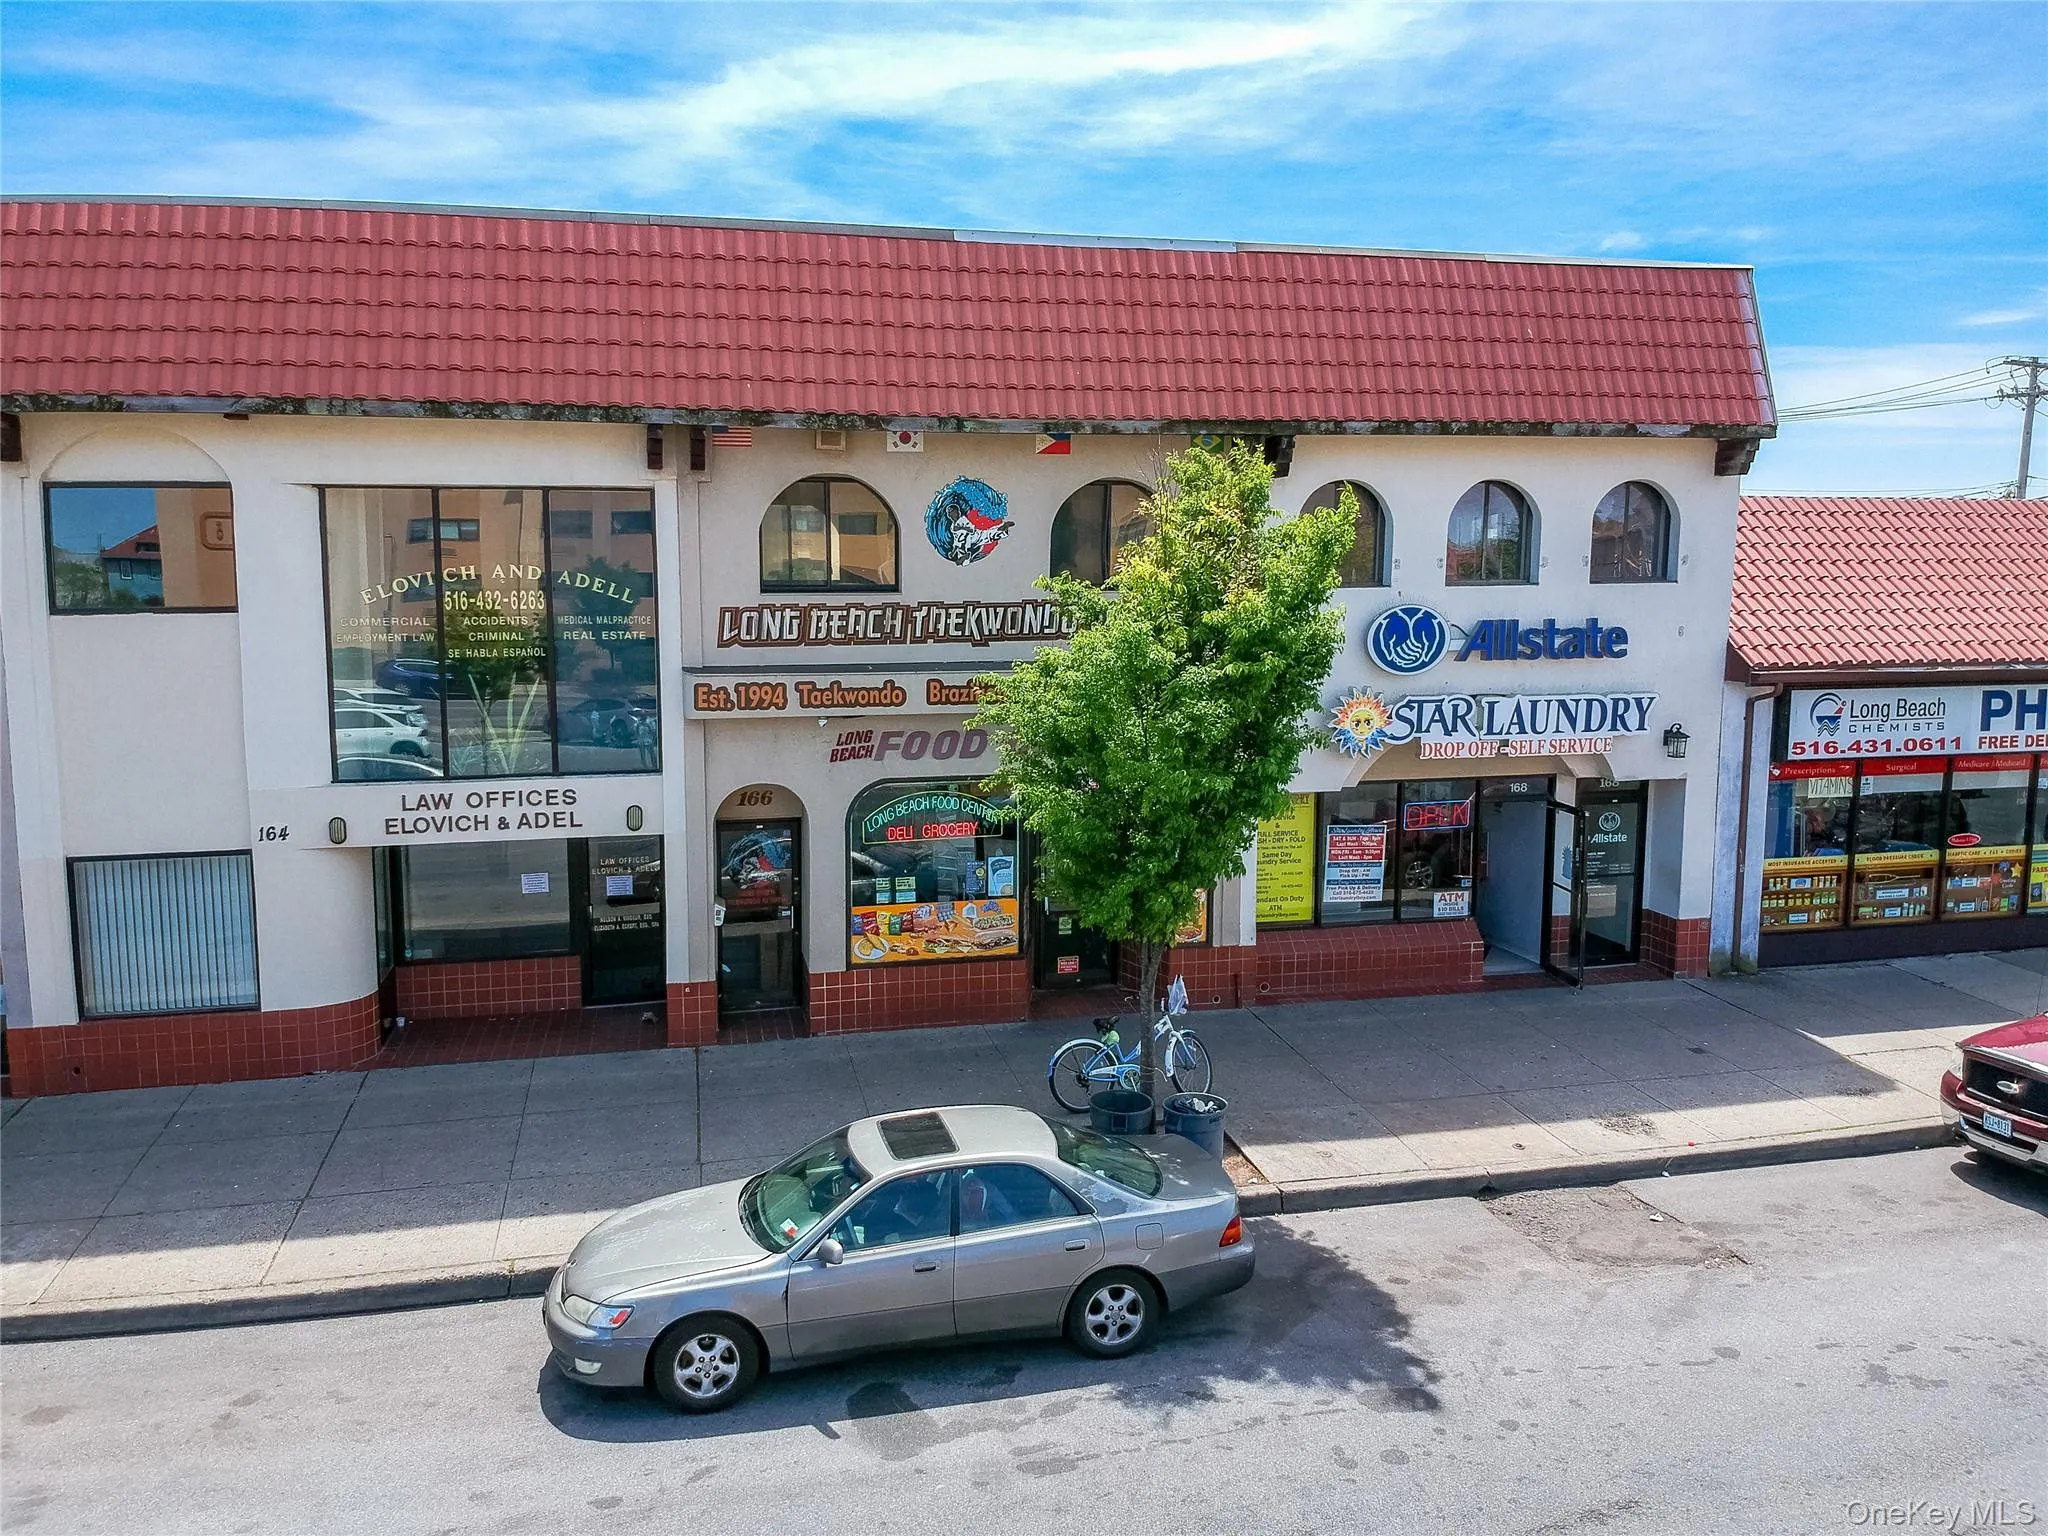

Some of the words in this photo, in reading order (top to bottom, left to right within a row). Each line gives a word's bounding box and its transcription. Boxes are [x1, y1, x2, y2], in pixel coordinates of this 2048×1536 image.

[360, 565, 477, 605] ELOVICH
[491, 564, 542, 580] AND
[557, 569, 634, 604] ADELL
[444, 590, 545, 610] 516-432-6263
[340, 616, 431, 627] COMMERCIAL
[463, 615, 529, 626] ACCIDENTS
[557, 615, 593, 625] MEDICAL
[596, 615, 652, 625] MALPRACTICE
[722, 607, 801, 641] LONG
[809, 606, 903, 640] BEACH
[336, 633, 408, 643] EMPLOYMENT
[412, 632, 435, 642] LAW
[468, 631, 525, 641] CRIMINAL
[563, 630, 597, 640] REAL
[601, 630, 647, 640] ESTATE
[1453, 617, 1629, 661] Allstate
[448, 648, 461, 658] SE
[466, 648, 498, 658] HABLA
[503, 645, 547, 657] ESPAÑOL
[696, 686, 733, 709] Est.
[739, 685, 786, 708] 1994
[798, 682, 904, 706] Taekwondo
[1387, 697, 1479, 740] STAR
[1482, 696, 1656, 736] LAUNDRY
[1849, 699, 1891, 723] Long
[1896, 697, 1946, 718] Beach
[1848, 721, 1945, 733] CHEMISTS
[836, 729, 874, 747] LONG
[874, 728, 989, 762] FOOD
[1420, 742, 1465, 758] DROP
[1471, 740, 1499, 756] OFF
[1510, 739, 1546, 755] SELF
[1549, 736, 1613, 754] SERVICE
[1791, 736, 1962, 756] 516.431.0611
[1978, 735, 2019, 749] FREE
[829, 744, 876, 763] BEACH
[1784, 766, 1836, 776] Prescriptions
[1886, 762, 1918, 772] Surgical
[1509, 782, 1528, 793] 168
[1808, 777, 1854, 796] VITAMINS
[401, 792, 454, 812] LAW
[465, 788, 578, 809] OFFICES
[735, 789, 774, 807] 166
[384, 814, 490, 835] ELOVICH
[497, 816, 511, 831] &
[517, 810, 584, 831] ADEL
[866, 807, 895, 832] LONG
[896, 796, 930, 816] BEACH
[931, 795, 960, 809] FOOD
[1406, 804, 1467, 828] OPEN
[257, 824, 290, 842] 164
[887, 825, 914, 841] DELI
[922, 821, 979, 839] GROCERY
[1272, 829, 1299, 837] SERVICE
[1590, 832, 1628, 844] Allstate
[600, 858, 616, 866] LAW
[618, 856, 650, 865] OFFICES
[1262, 851, 1280, 859] Same
[1280, 850, 1293, 860] Day
[1279, 857, 1302, 865] Service
[592, 866, 624, 875] ELOVICH
[1290, 894, 1305, 903] Duty
[1438, 892, 1465, 903] ATM
